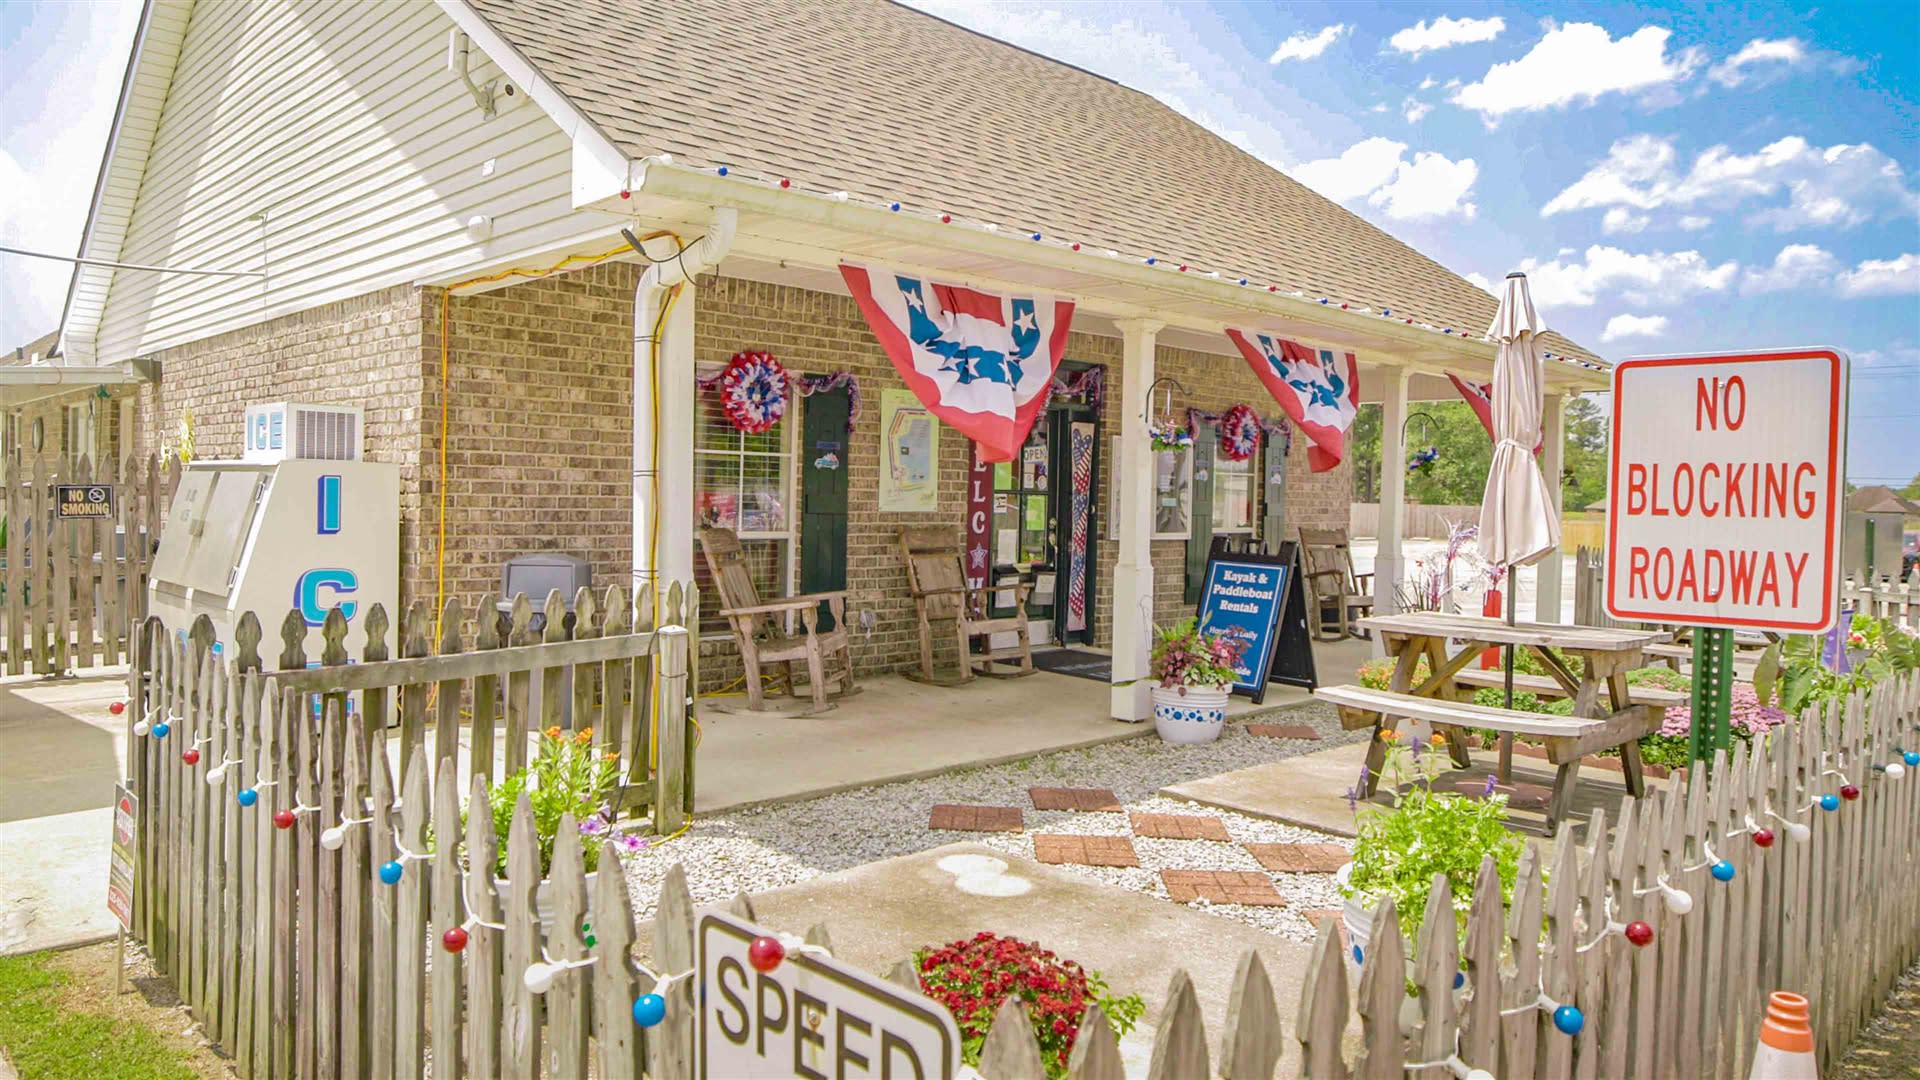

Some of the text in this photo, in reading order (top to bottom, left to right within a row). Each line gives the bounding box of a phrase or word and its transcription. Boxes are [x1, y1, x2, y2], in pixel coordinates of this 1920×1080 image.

[1695, 375, 1746, 432] NO
[247, 412, 282, 450] ICE
[68, 489, 84, 502] NO
[1626, 461, 1817, 519] BLOCKING
[61, 502, 110, 515] SMOKING
[1223, 570, 1268, 584] Kayak &
[1628, 546, 1810, 609] ROADWAY
[1212, 583, 1273, 600] Paddleboat
[1219, 599, 1259, 614] Rentals
[715, 955, 926, 1080] SPEED
